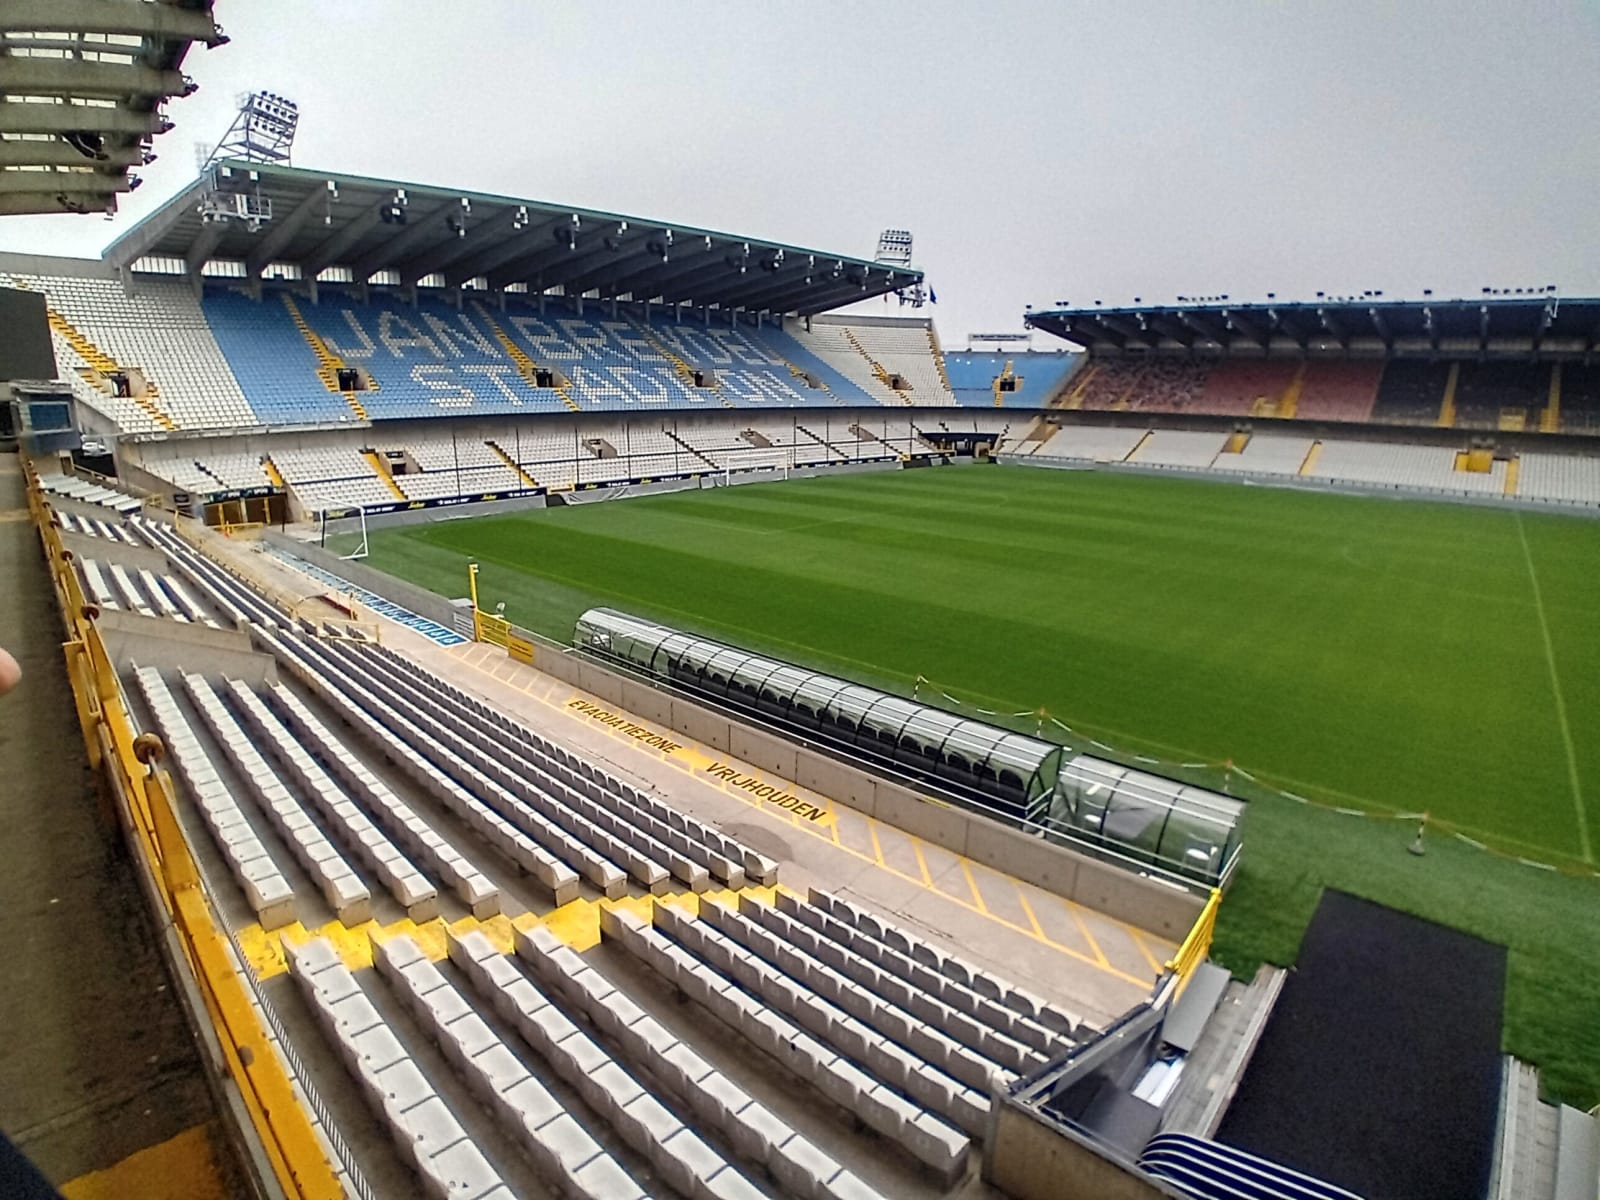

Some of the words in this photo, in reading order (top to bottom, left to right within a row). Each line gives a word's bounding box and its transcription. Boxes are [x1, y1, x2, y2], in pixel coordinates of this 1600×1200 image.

[322, 310, 502, 358] JAN
[509, 316, 786, 365] BREYDEL
[410, 364, 806, 408] STADION
[568, 699, 683, 754] EVACUATIEZONE
[705, 762, 826, 822] VRIJHOUDEN
